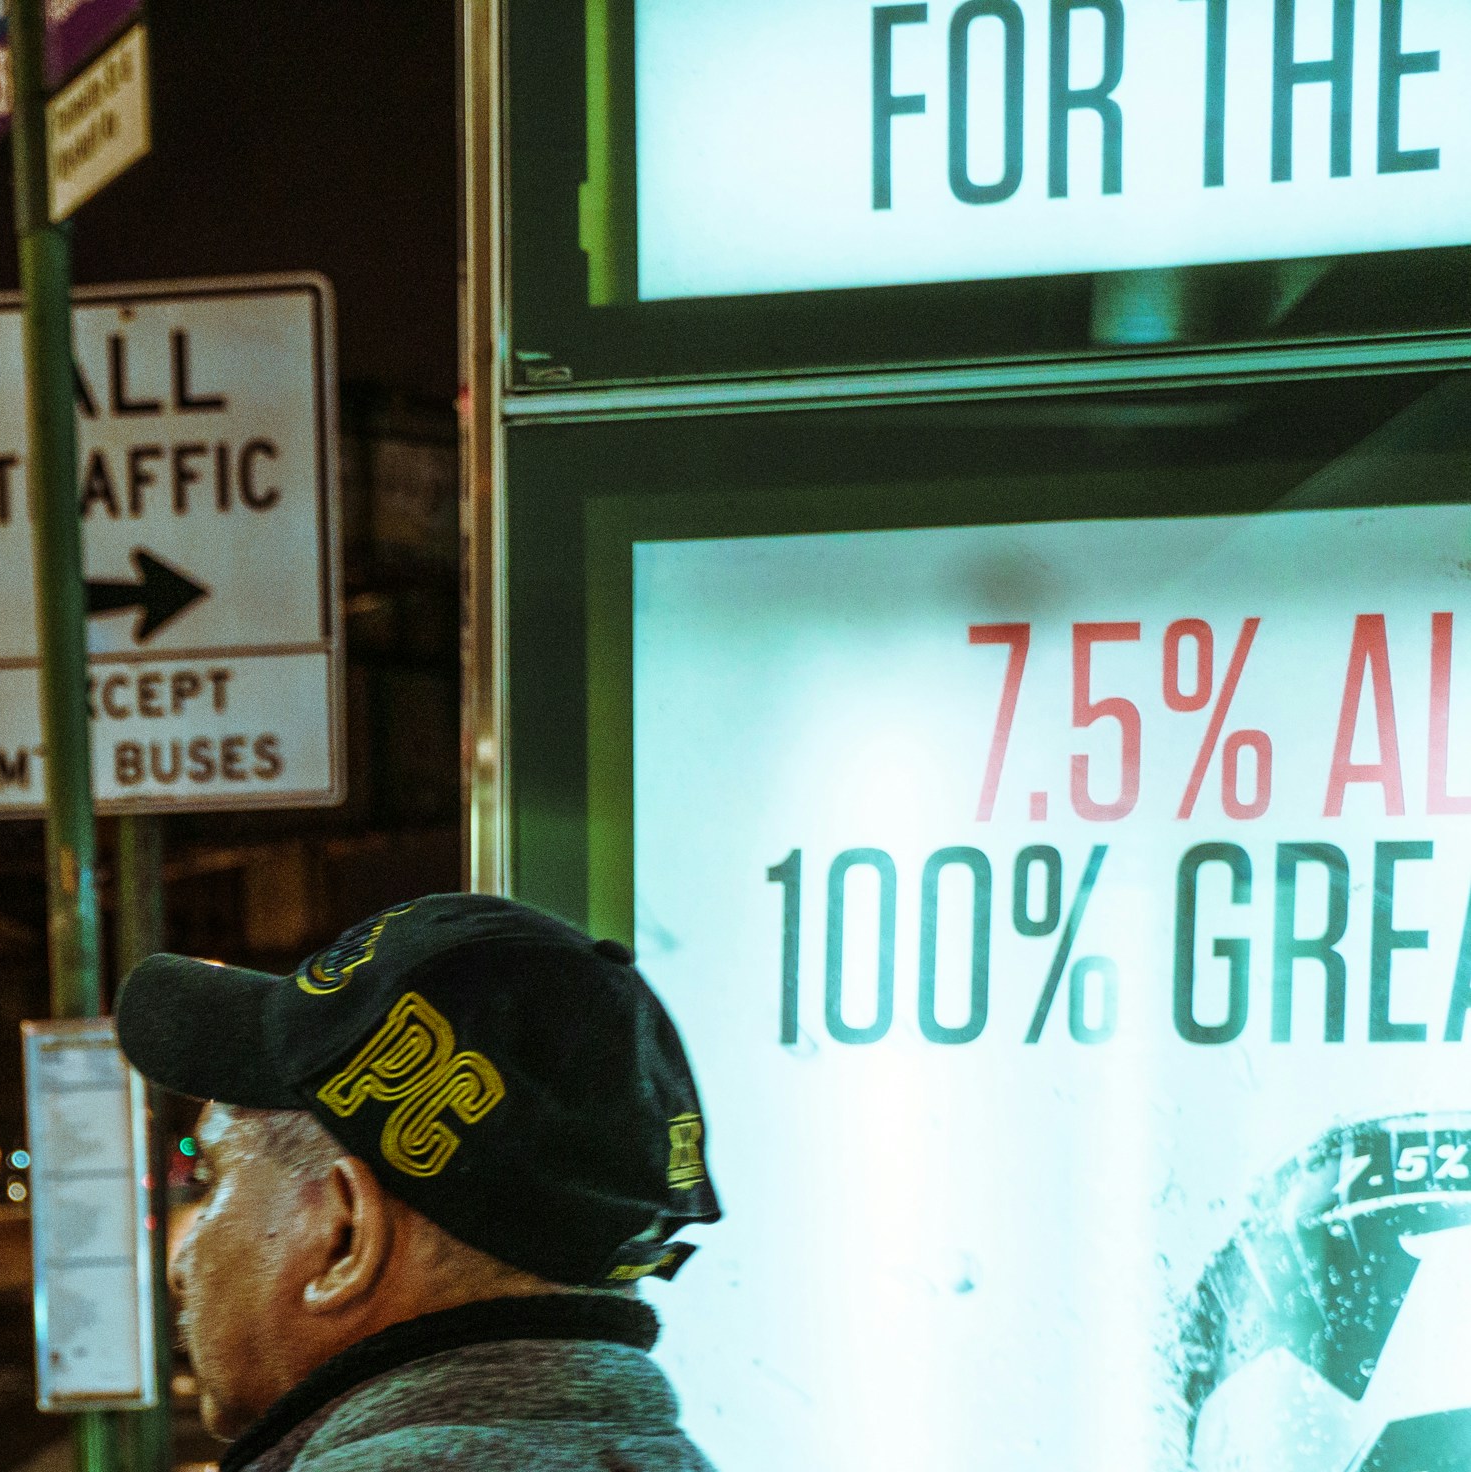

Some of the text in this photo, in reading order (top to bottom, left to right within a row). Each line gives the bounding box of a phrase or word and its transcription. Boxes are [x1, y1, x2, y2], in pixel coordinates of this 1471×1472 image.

[871, 0, 1441, 210] FOR THE
[88, 666, 236, 721] CEPT
[113, 732, 287, 787] BUSES
[968, 616, 1273, 822] 7.5%
[766, 842, 1119, 1046] 100%
